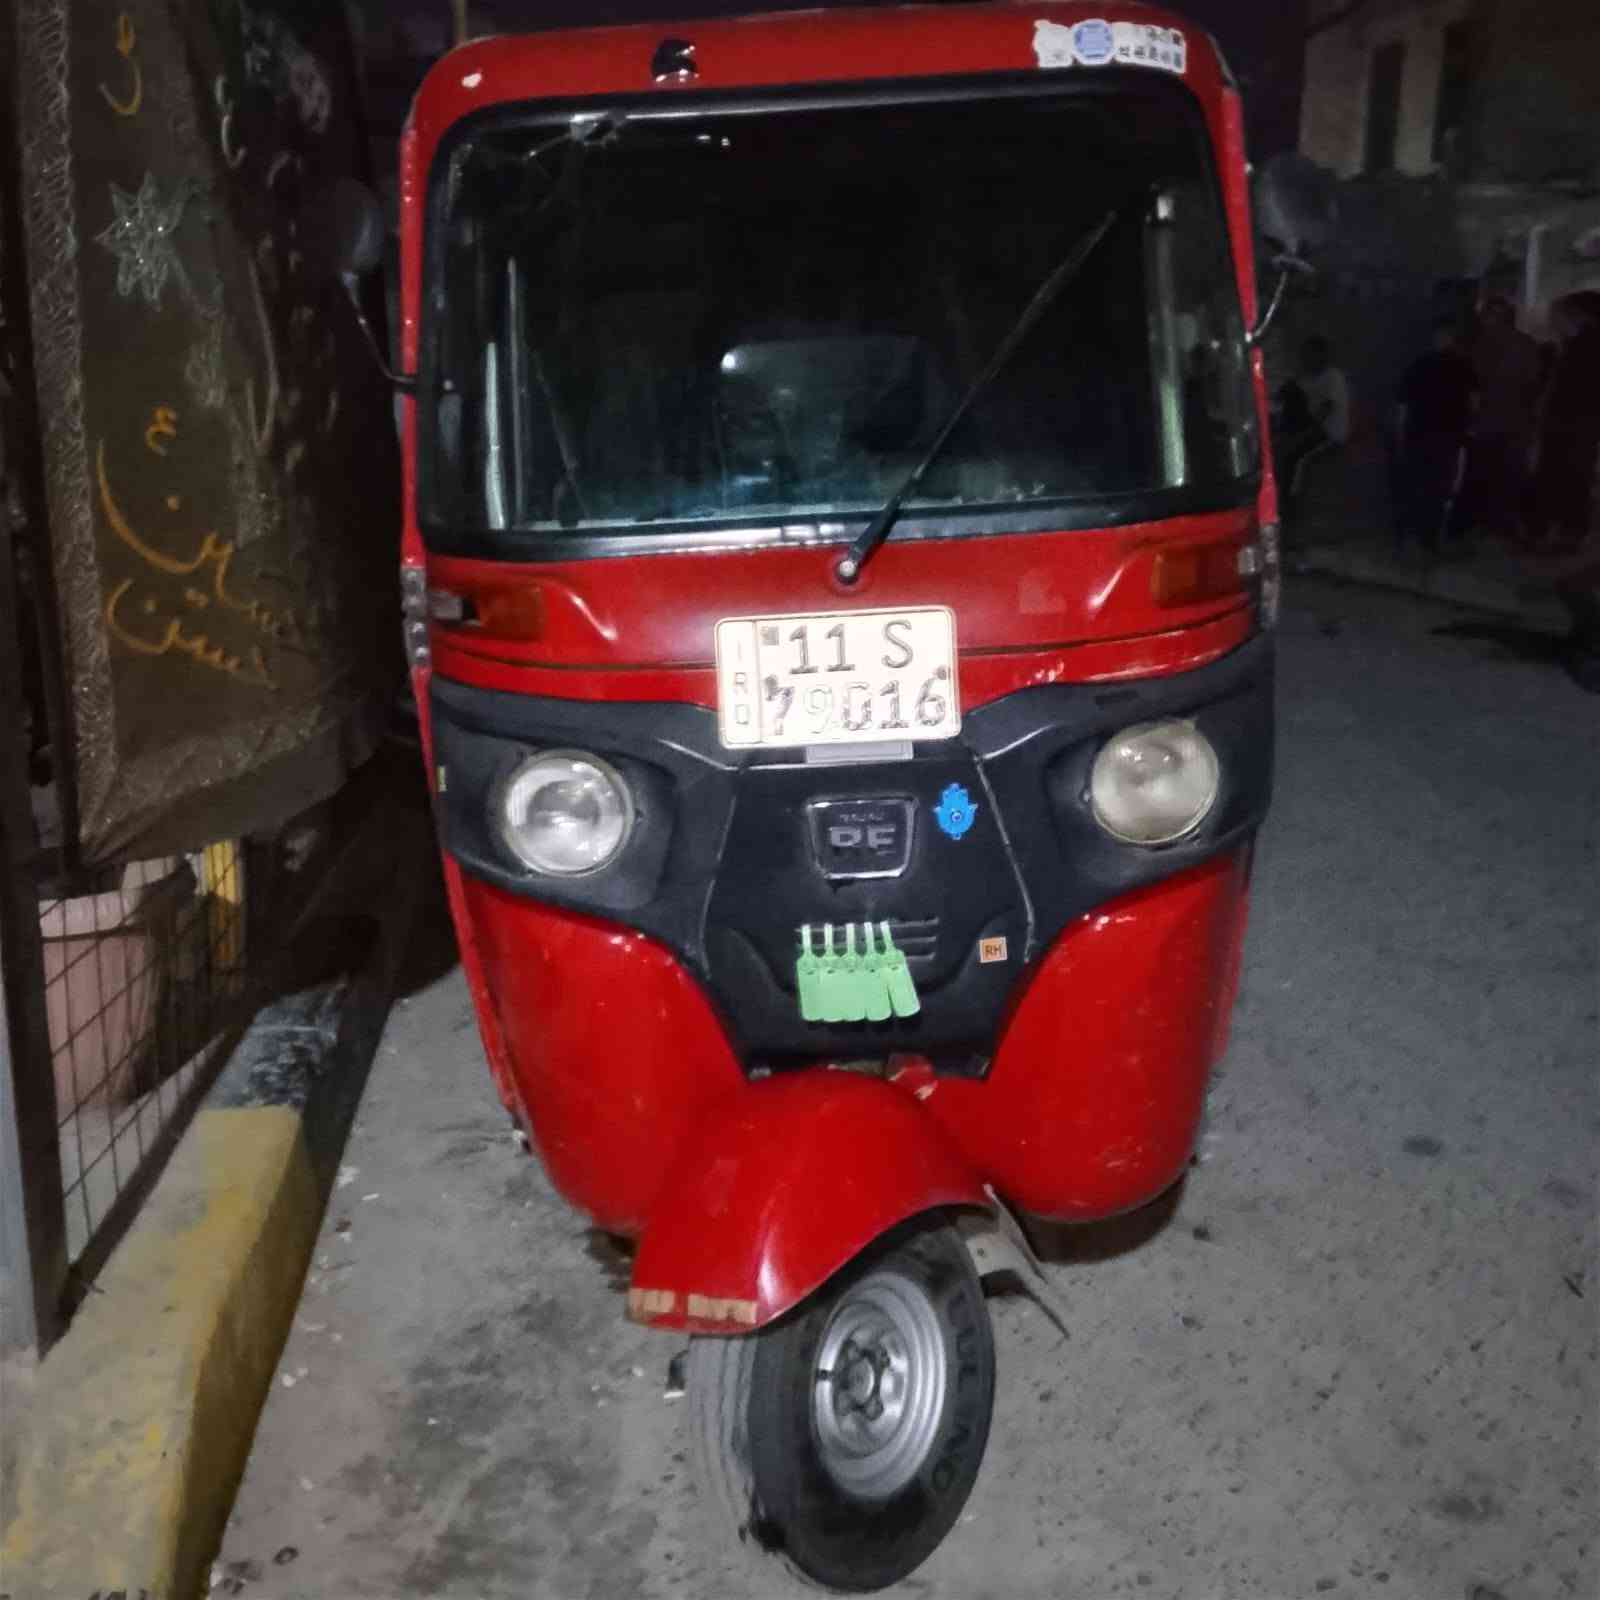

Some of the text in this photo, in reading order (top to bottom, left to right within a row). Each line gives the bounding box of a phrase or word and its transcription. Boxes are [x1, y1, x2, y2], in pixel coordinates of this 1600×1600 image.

[789, 619, 914, 675] 11 S
[765, 677, 947, 736] 79016
